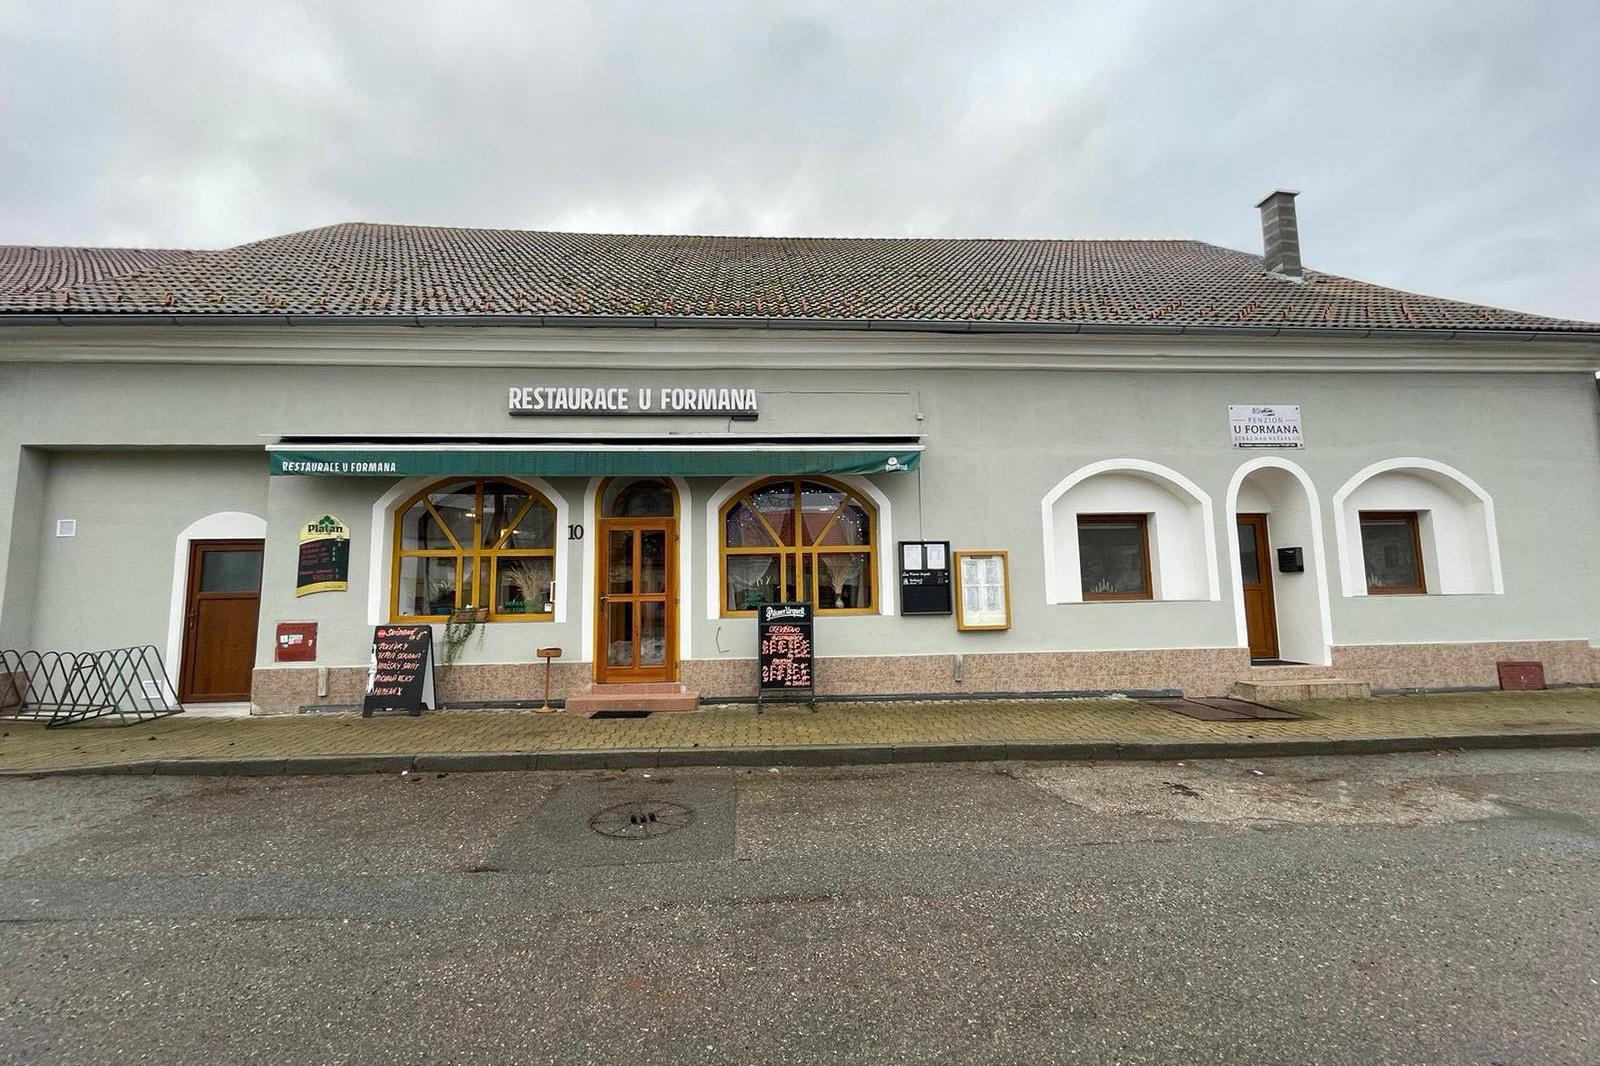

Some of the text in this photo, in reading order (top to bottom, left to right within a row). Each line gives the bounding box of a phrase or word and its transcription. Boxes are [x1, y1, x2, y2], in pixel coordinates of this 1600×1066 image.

[508, 387, 758, 410] RESTAURACE U FORMANA
[1233, 425, 1299, 434] U FORMANA
[282, 461, 397, 473] RESTAURACE U FORMANA
[308, 523, 343, 534] Platan
[568, 524, 584, 540] 10
